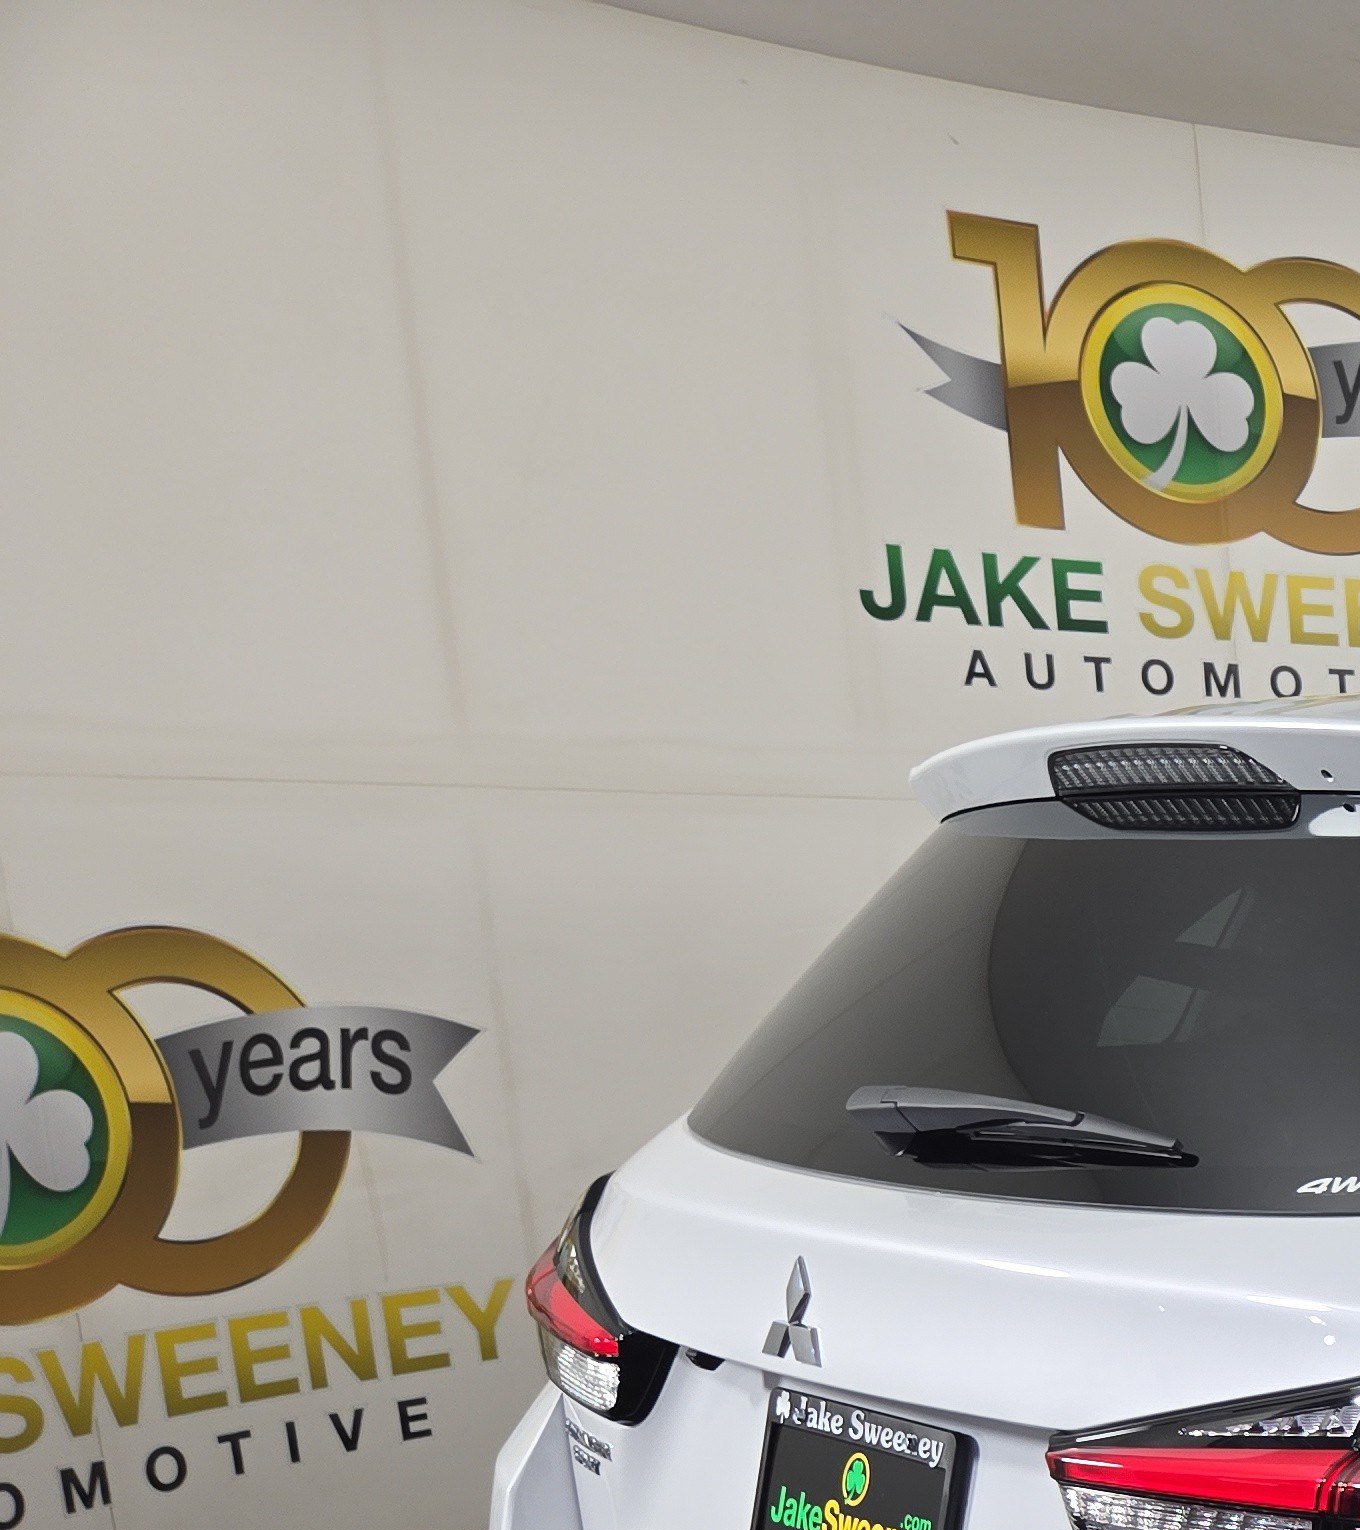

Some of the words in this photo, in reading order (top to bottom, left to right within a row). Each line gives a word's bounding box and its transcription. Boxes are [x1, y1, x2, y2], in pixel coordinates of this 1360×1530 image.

[859, 543, 1109, 635] JAKE
[188, 1027, 413, 1129] years
[792, 1396, 843, 1436] Jake
